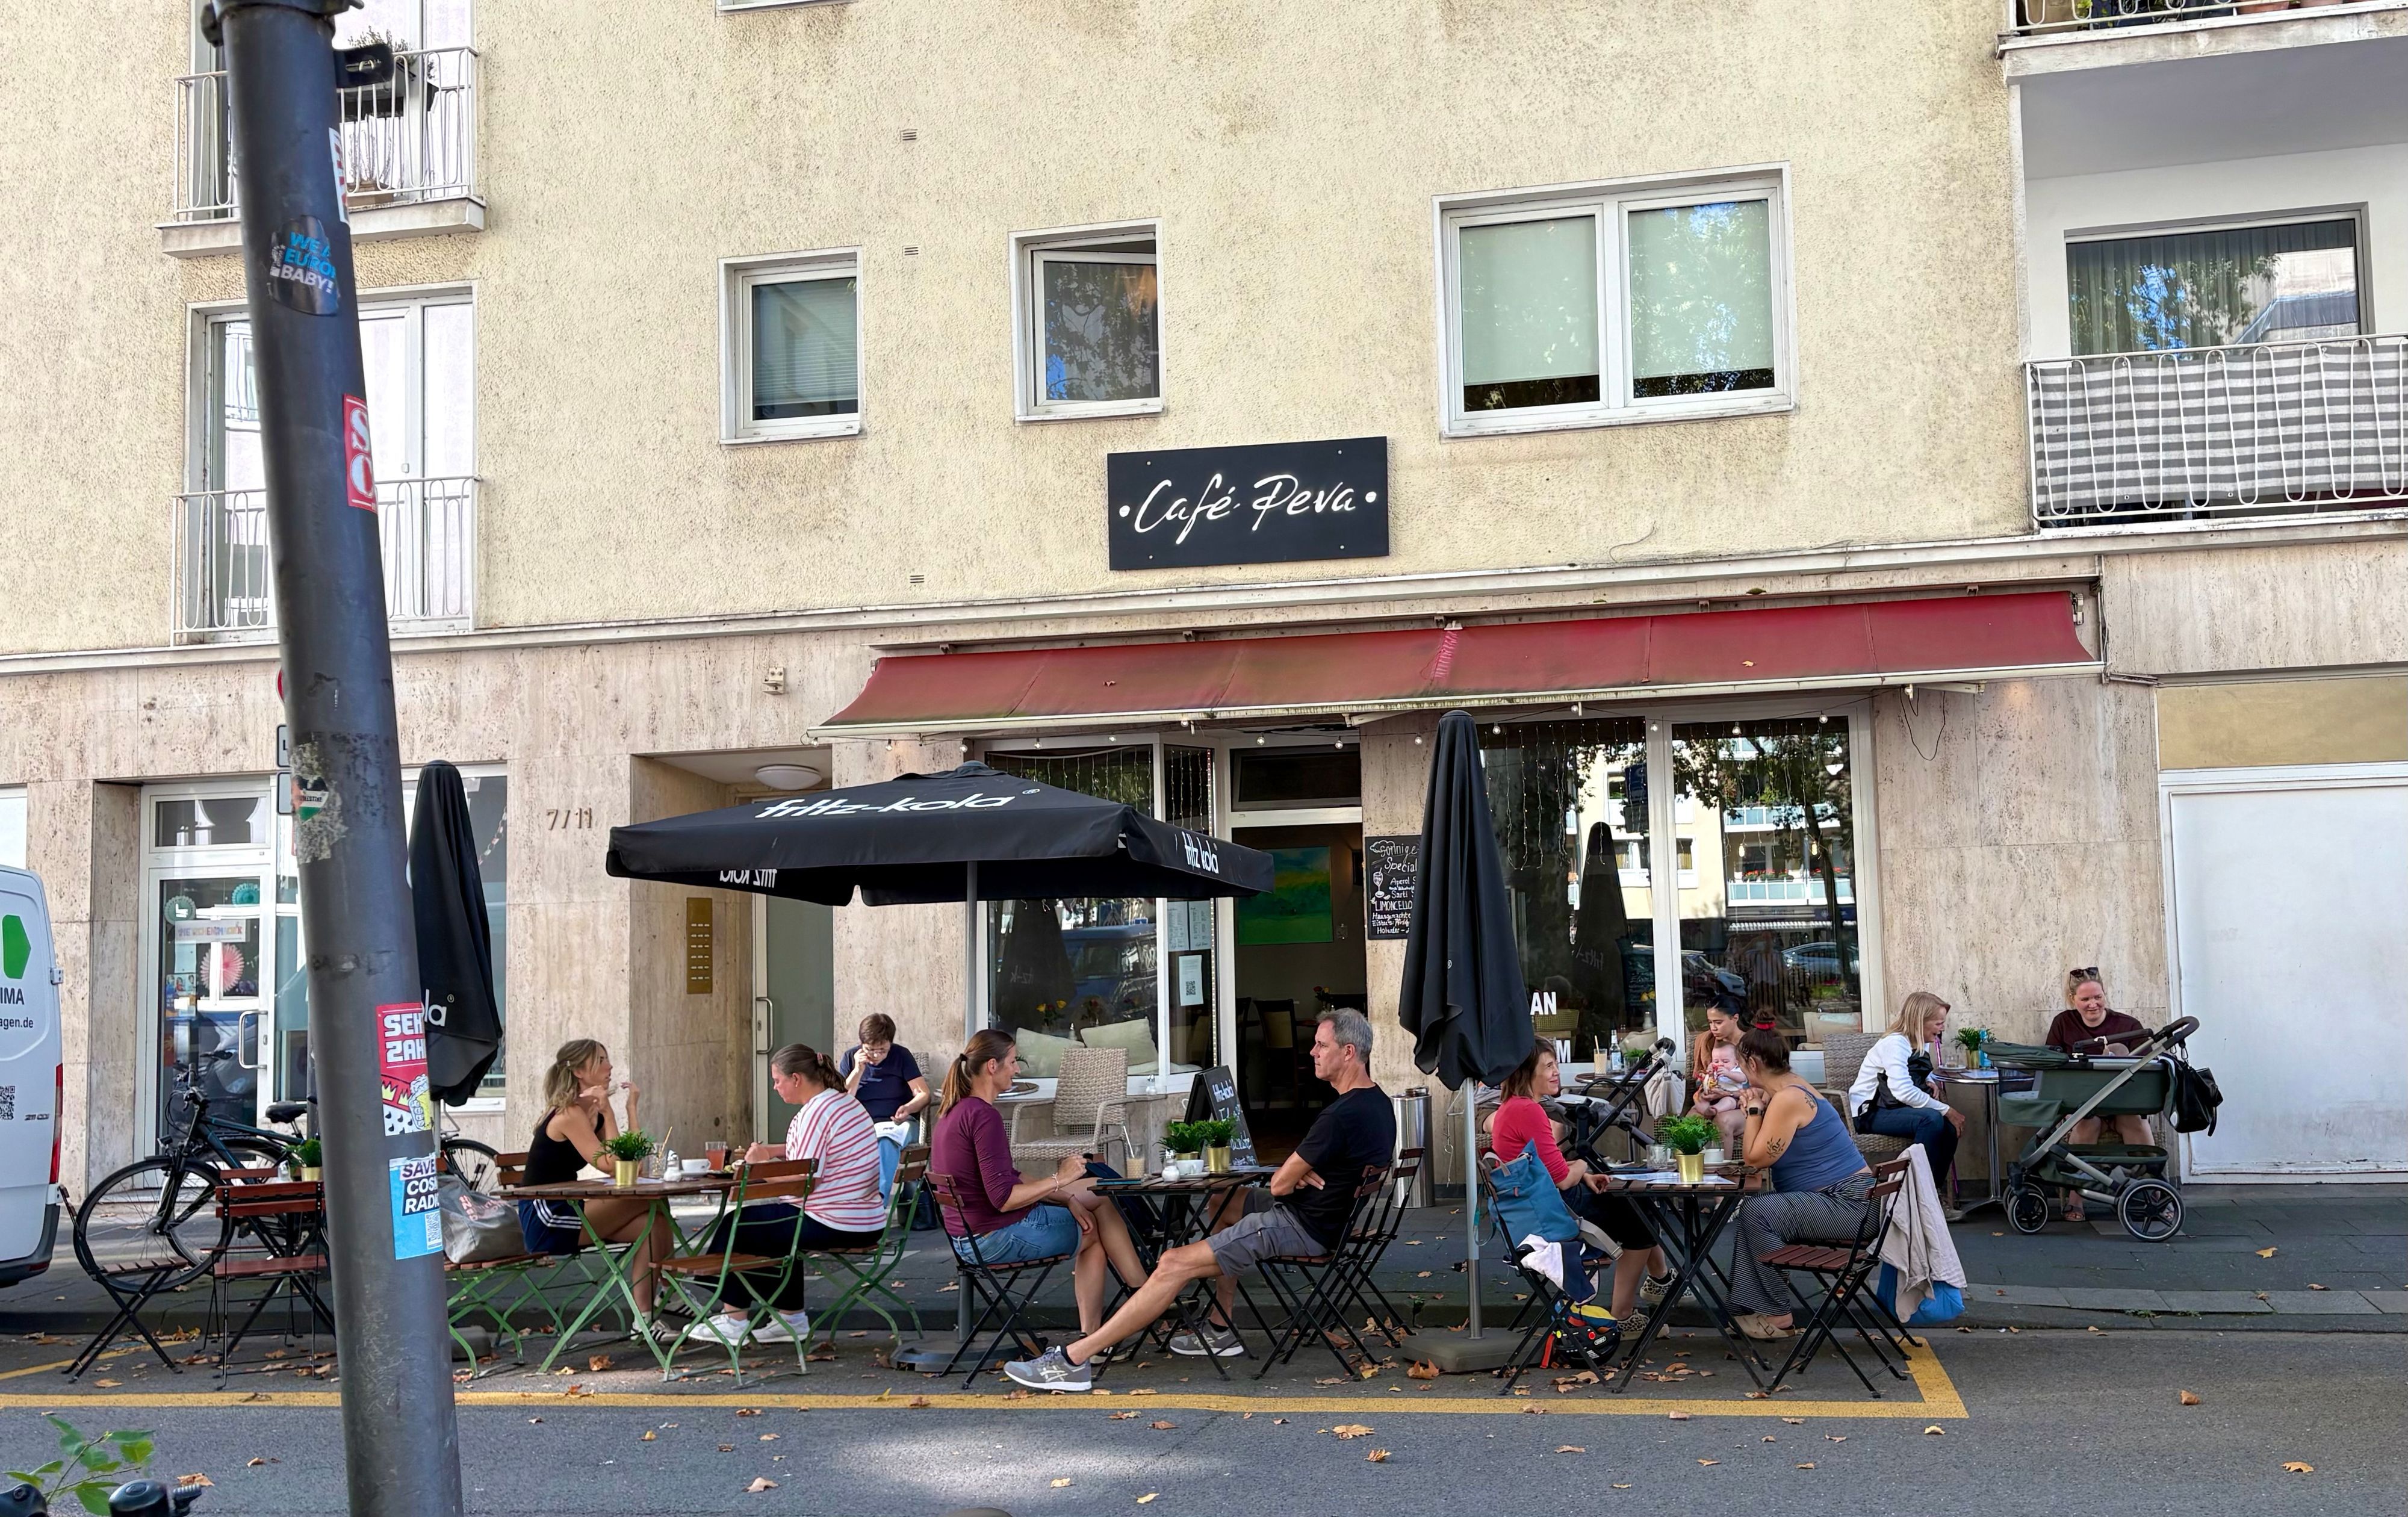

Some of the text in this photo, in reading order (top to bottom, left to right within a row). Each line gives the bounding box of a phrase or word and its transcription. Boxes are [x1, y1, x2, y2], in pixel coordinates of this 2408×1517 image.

[290, 231, 321, 253] WE
[281, 264, 335, 294] BABY!
[1134, 473, 1356, 545] Café Peva
[754, 792, 1016, 819] fritz-kola
[1390, 876, 1410, 889] Aperol
[1391, 890, 1408, 899] Sarti
[1375, 900, 1413, 911] LIMONCELLO
[402, 1159, 435, 1178] SAVE
